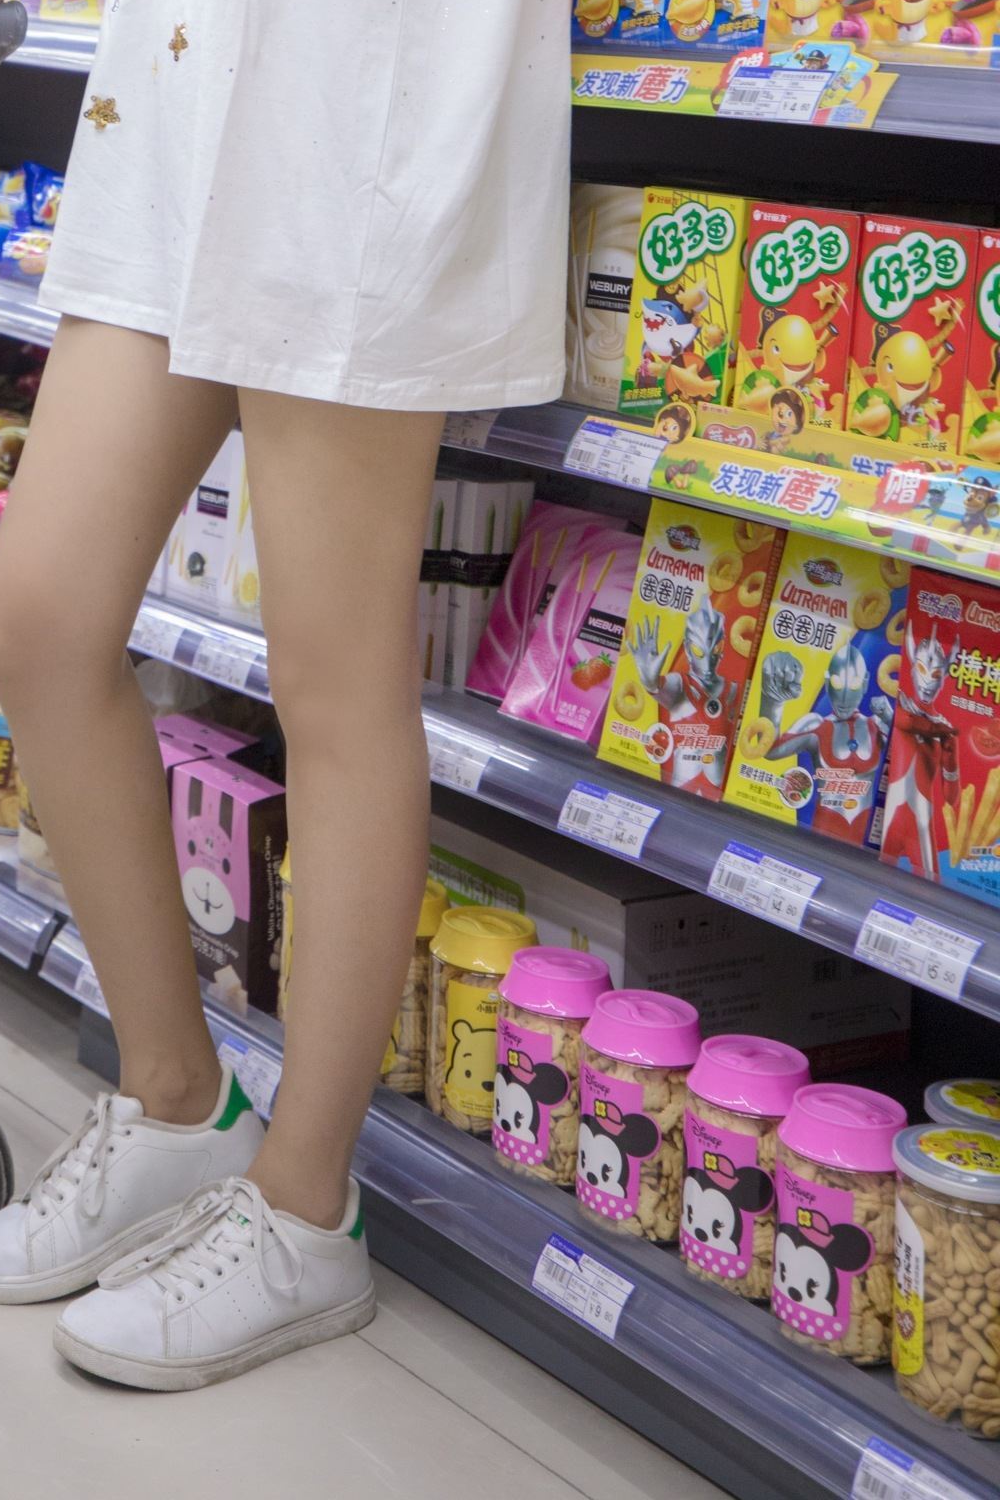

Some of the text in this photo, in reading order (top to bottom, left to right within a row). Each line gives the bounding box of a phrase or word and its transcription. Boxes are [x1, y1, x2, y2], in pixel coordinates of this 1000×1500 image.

[648, 209, 727, 275] 好多鱼
[756, 226, 841, 295] 好多鱼
[870, 239, 958, 311] 好多鱼
[590, 279, 631, 296] WEBURY
[647, 548, 704, 582] ULTRAMAN
[780, 580, 847, 619] ULTRAMAN
[585, 1067, 610, 1097] Disney
[692, 1118, 722, 1148] Disney
[783, 1171, 816, 1204] Disney
